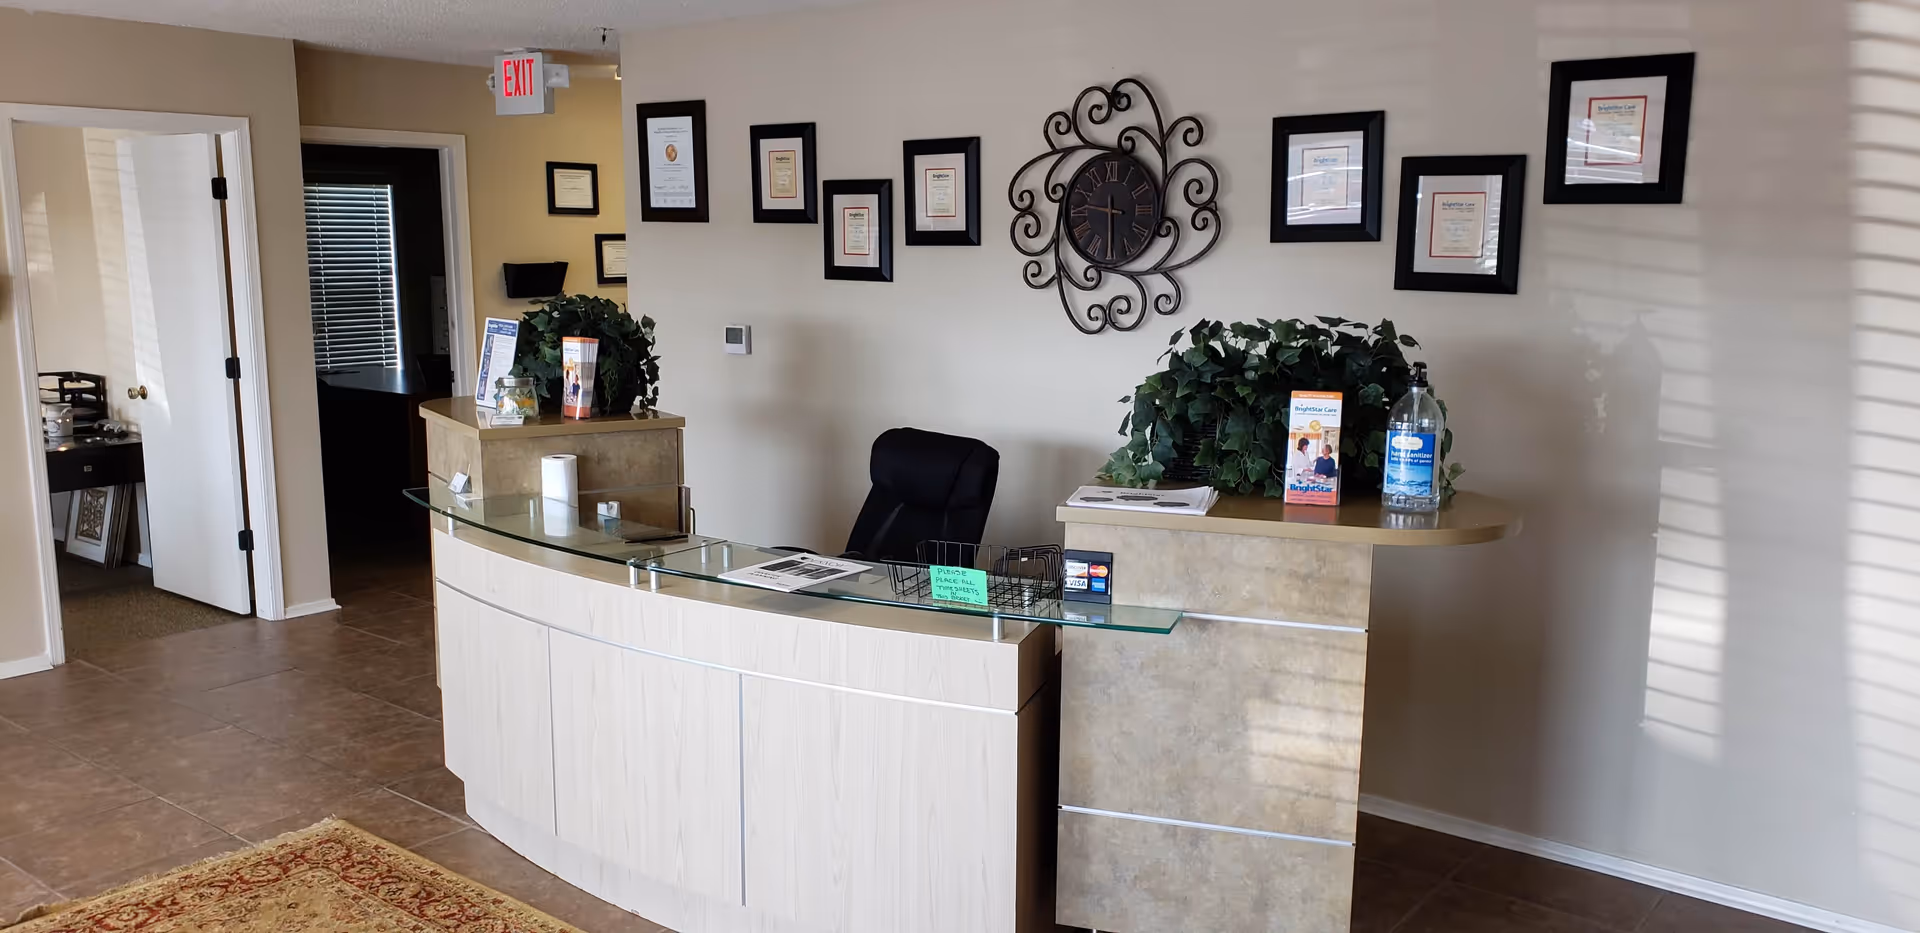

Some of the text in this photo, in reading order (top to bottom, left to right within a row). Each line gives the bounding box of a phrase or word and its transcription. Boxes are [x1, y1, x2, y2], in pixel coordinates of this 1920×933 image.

[503, 59, 534, 97] EXIT
[1104, 161, 1119, 182] XII
[1135, 204, 1153, 216] III
[1294, 405, 1323, 413] BrightStar
[1290, 483, 1333, 494] BrightStar
[937, 568, 967, 576] PLEASE
[936, 577, 958, 585] PLACE
[1069, 579, 1087, 587] VISA
